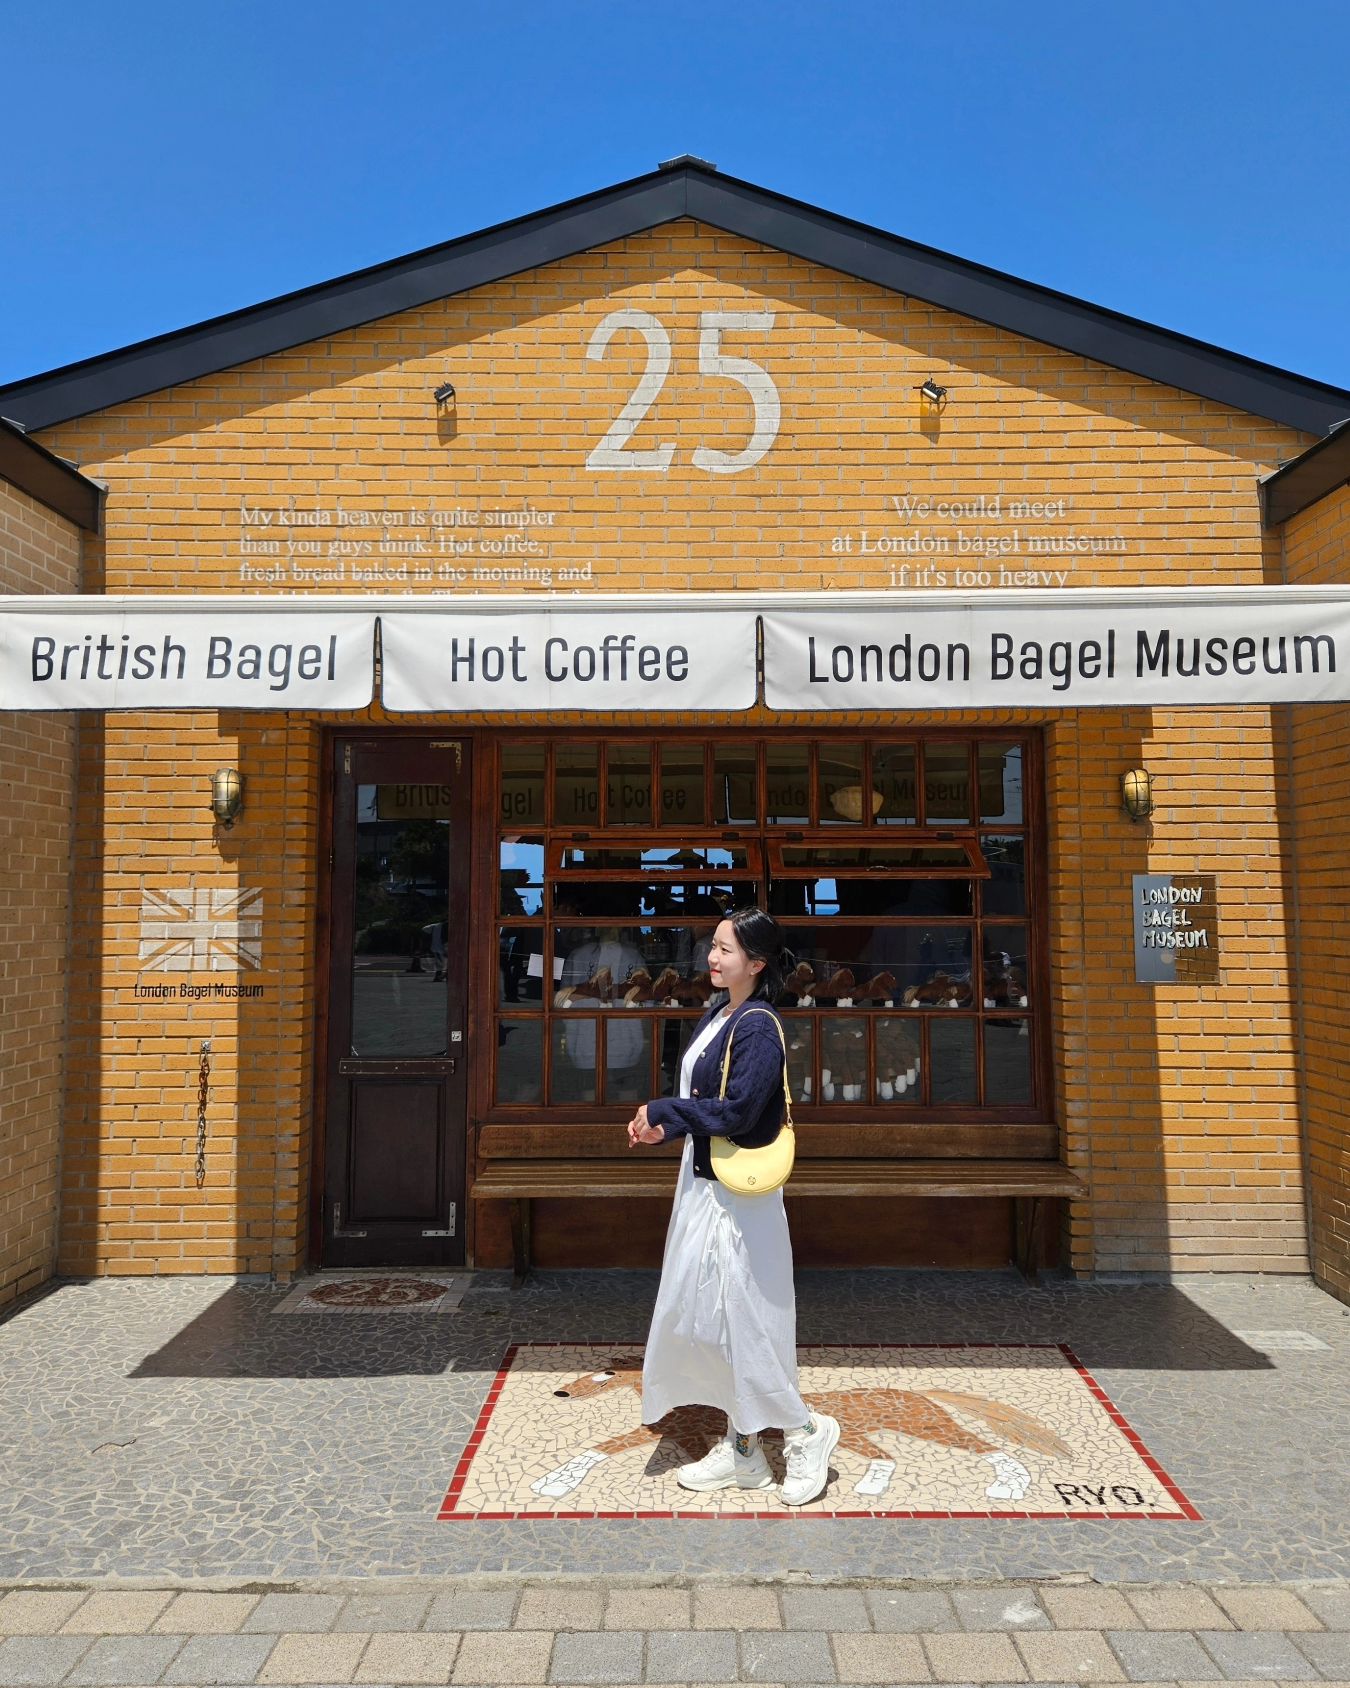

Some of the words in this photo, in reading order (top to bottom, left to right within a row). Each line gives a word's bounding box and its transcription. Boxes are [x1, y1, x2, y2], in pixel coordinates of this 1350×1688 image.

[586, 309, 780, 473] 25
[892, 496, 929, 518] We
[936, 495, 1001, 518] could
[1009, 498, 1066, 518] meet
[239, 508, 274, 530] My
[278, 507, 331, 526] kinda
[337, 508, 404, 526] heaven
[410, 507, 427, 526] is
[431, 507, 480, 531] quite
[485, 507, 556, 531] simpler
[239, 536, 280, 554] than
[286, 540, 324, 559] you
[328, 539, 373, 559] guys
[379, 535, 433, 554] think.
[438, 536, 475, 554] Hot
[479, 535, 545, 557] coffee,
[831, 534, 853, 553] at
[859, 530, 949, 554] London
[957, 530, 1019, 559] bagel
[1028, 535, 1128, 552] museum
[239, 563, 287, 582] fresh
[291, 562, 345, 582] bread
[351, 562, 408, 582] baked
[413, 563, 433, 581] in
[438, 562, 468, 581] the
[472, 562, 553, 586] morning
[558, 562, 594, 581] and
[889, 564, 911, 587] if
[915, 564, 946, 586] it's
[955, 568, 992, 586] too
[999, 564, 1069, 588] heavy
[31, 634, 187, 682] British
[206, 635, 337, 691] Bagel
[450, 637, 528, 683] Hot
[543, 634, 688, 682] Coffee
[808, 634, 970, 683] London
[990, 629, 1116, 691] Bagel
[1135, 629, 1337, 677] Museum
[1142, 886, 1202, 905] LONDON
[1143, 908, 1192, 928] BAGEL
[1143, 929, 1208, 949] MUSEUM
[134, 983, 176, 998] London
[180, 983, 211, 1000] Bagel
[215, 983, 264, 997] Museum
